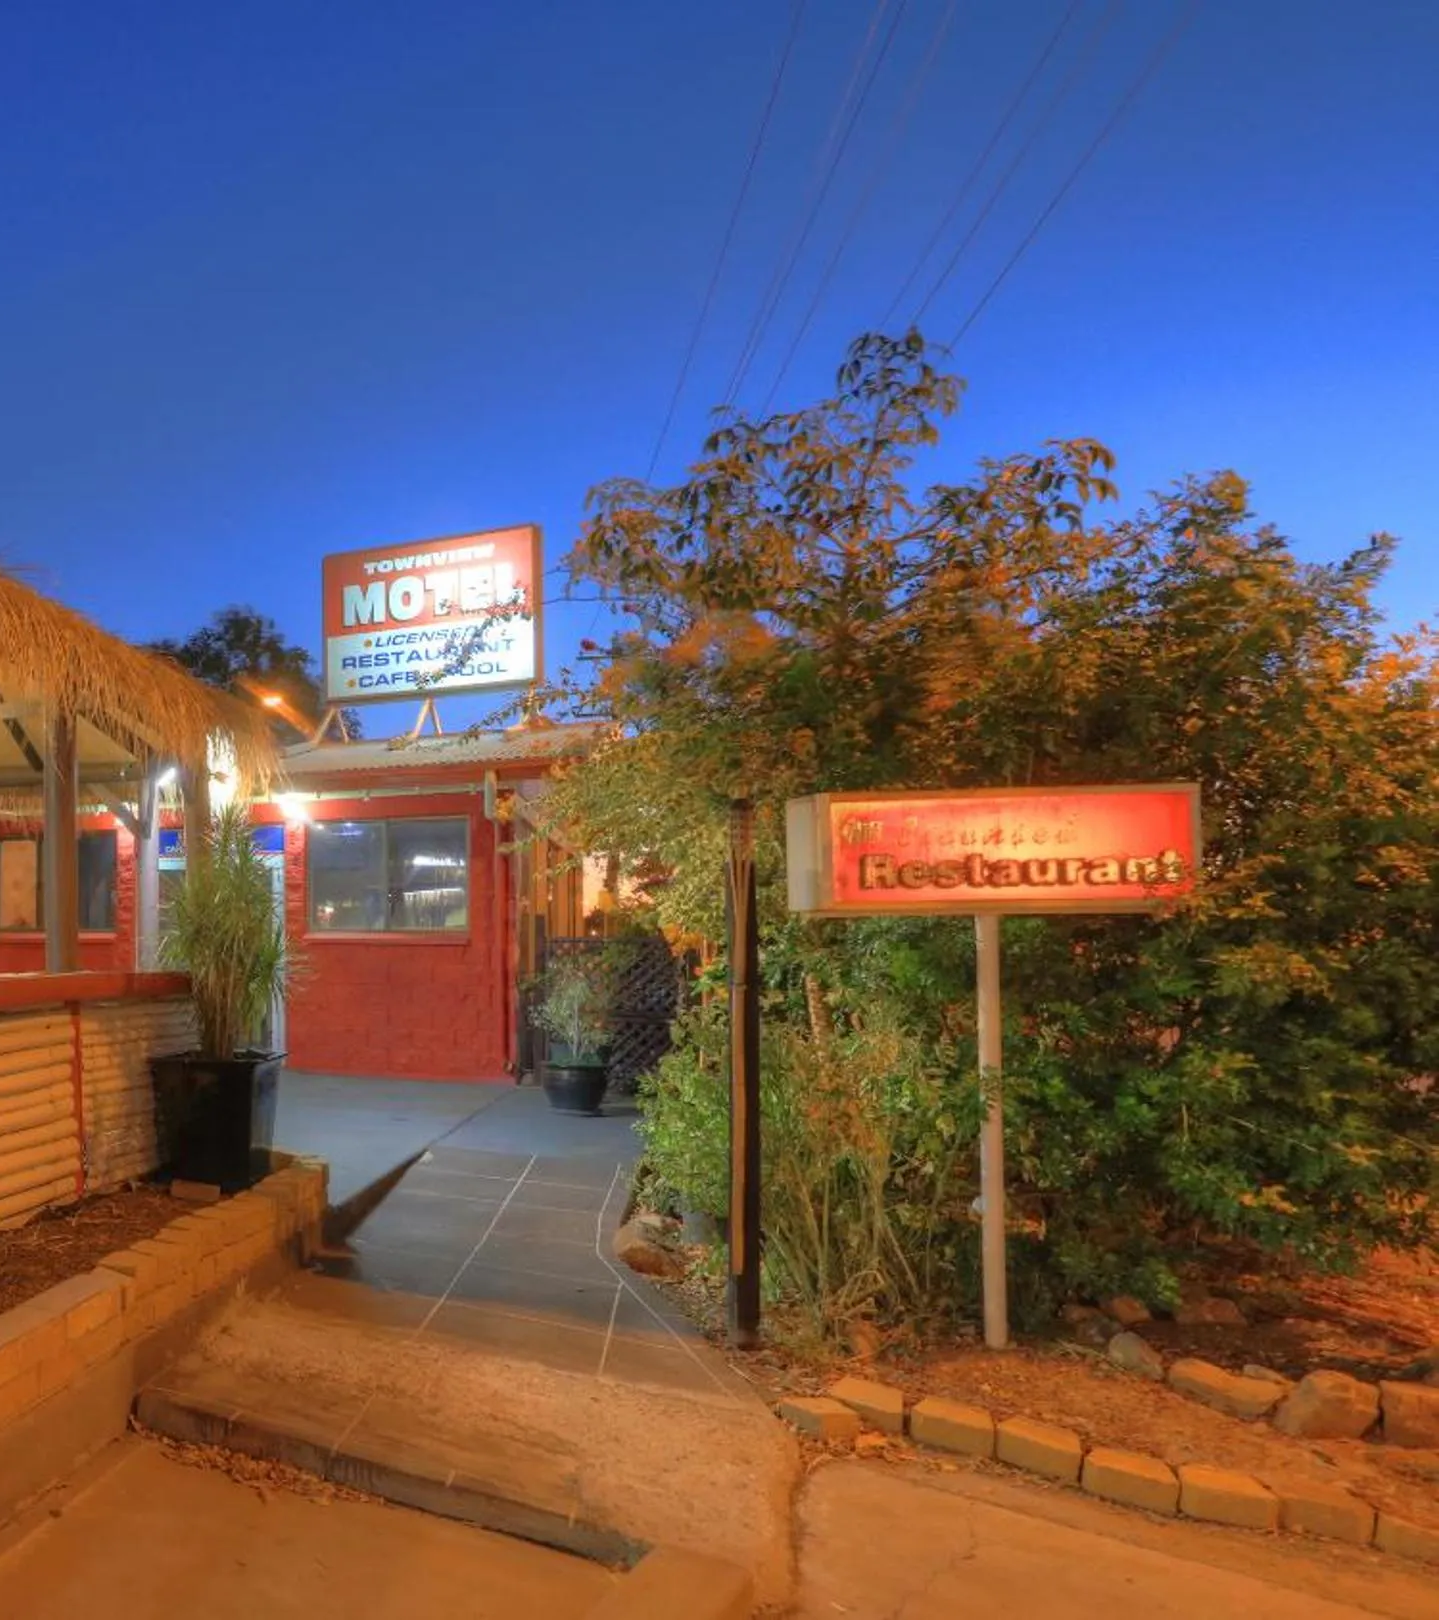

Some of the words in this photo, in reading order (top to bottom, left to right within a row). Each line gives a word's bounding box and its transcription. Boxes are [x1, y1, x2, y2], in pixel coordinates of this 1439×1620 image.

[342, 562, 526, 627] MOTEL
[446, 661, 508, 677] OOL
[859, 849, 1183, 890] Restaurant
